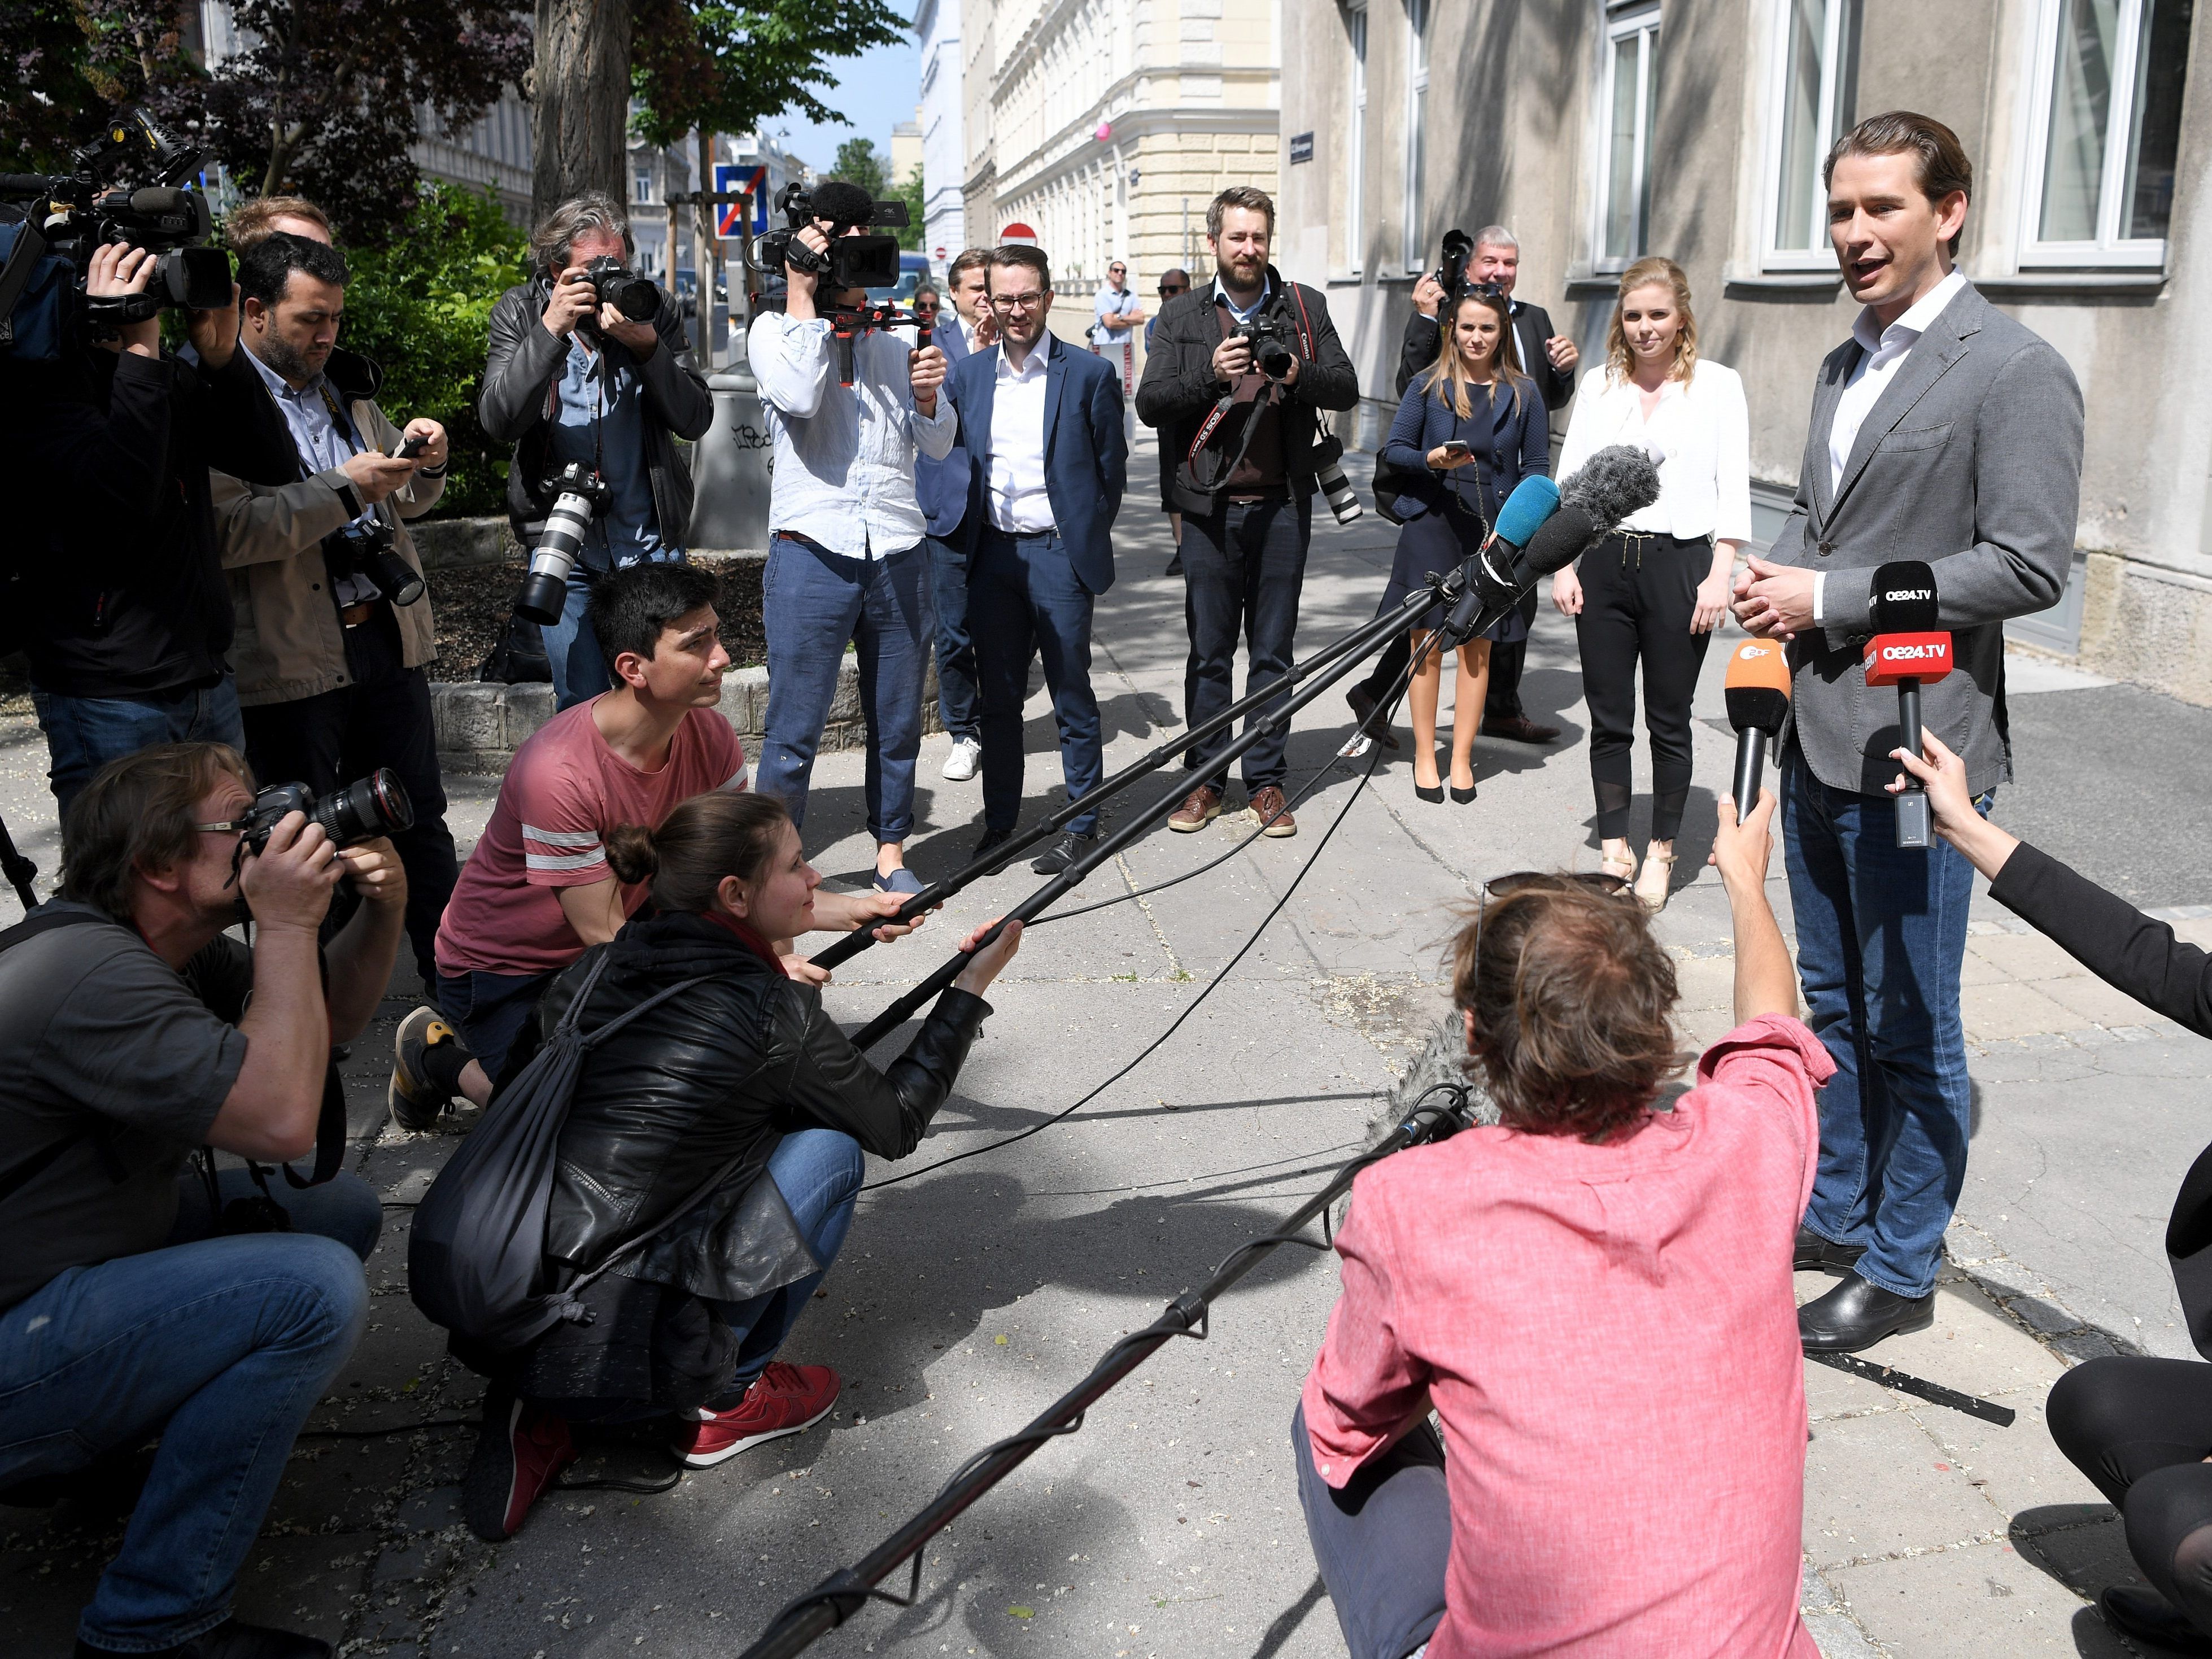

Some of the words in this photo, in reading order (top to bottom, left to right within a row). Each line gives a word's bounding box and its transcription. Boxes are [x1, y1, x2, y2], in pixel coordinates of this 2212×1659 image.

[1301, 332, 1310, 360] Canon
[1206, 412, 1220, 431] EOS
[1200, 430, 1208, 440] 5D
